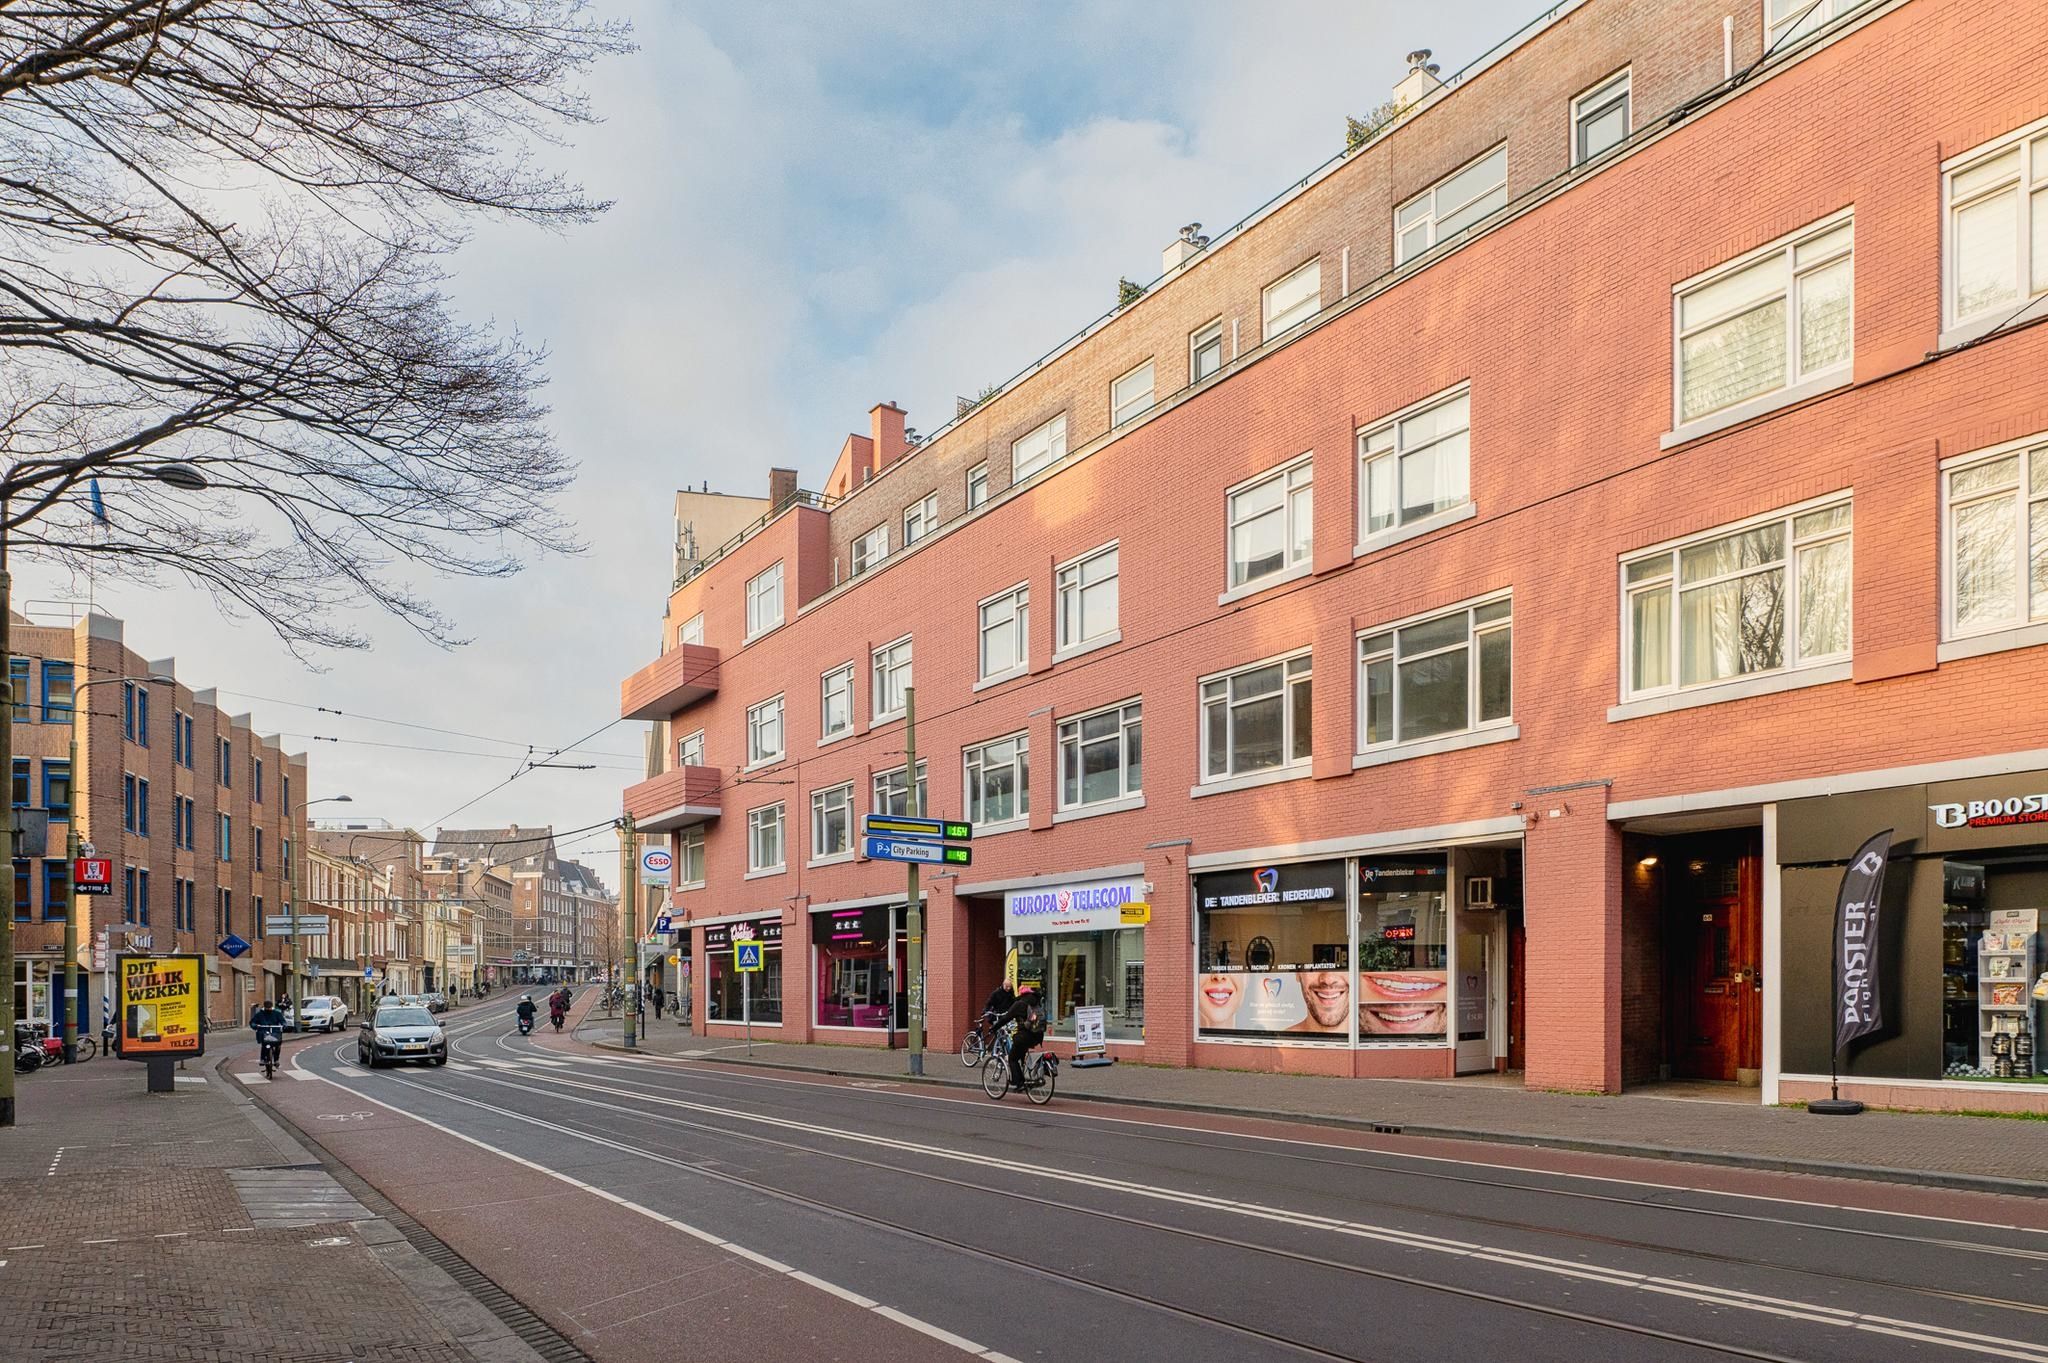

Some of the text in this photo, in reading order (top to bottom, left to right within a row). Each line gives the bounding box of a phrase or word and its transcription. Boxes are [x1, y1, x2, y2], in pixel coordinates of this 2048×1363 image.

[1969, 817, 2016, 826] PREMIUM
[893, 845, 906, 856] City
[905, 847, 930, 858] Parking
[648, 856, 669, 865] Esso
[1375, 868, 1415, 877] Tandenbleker
[1282, 887, 1334, 902] NEDERLAND
[1012, 886, 1132, 916] EUROPA TELECOM
[659, 919, 668, 930] P
[1385, 927, 1414, 938] OPEN
[127, 961, 157, 976] DIT
[127, 970, 184, 990] WIL IK
[127, 982, 191, 1002] WEKEN
[170, 1039, 195, 1047] TELE2
